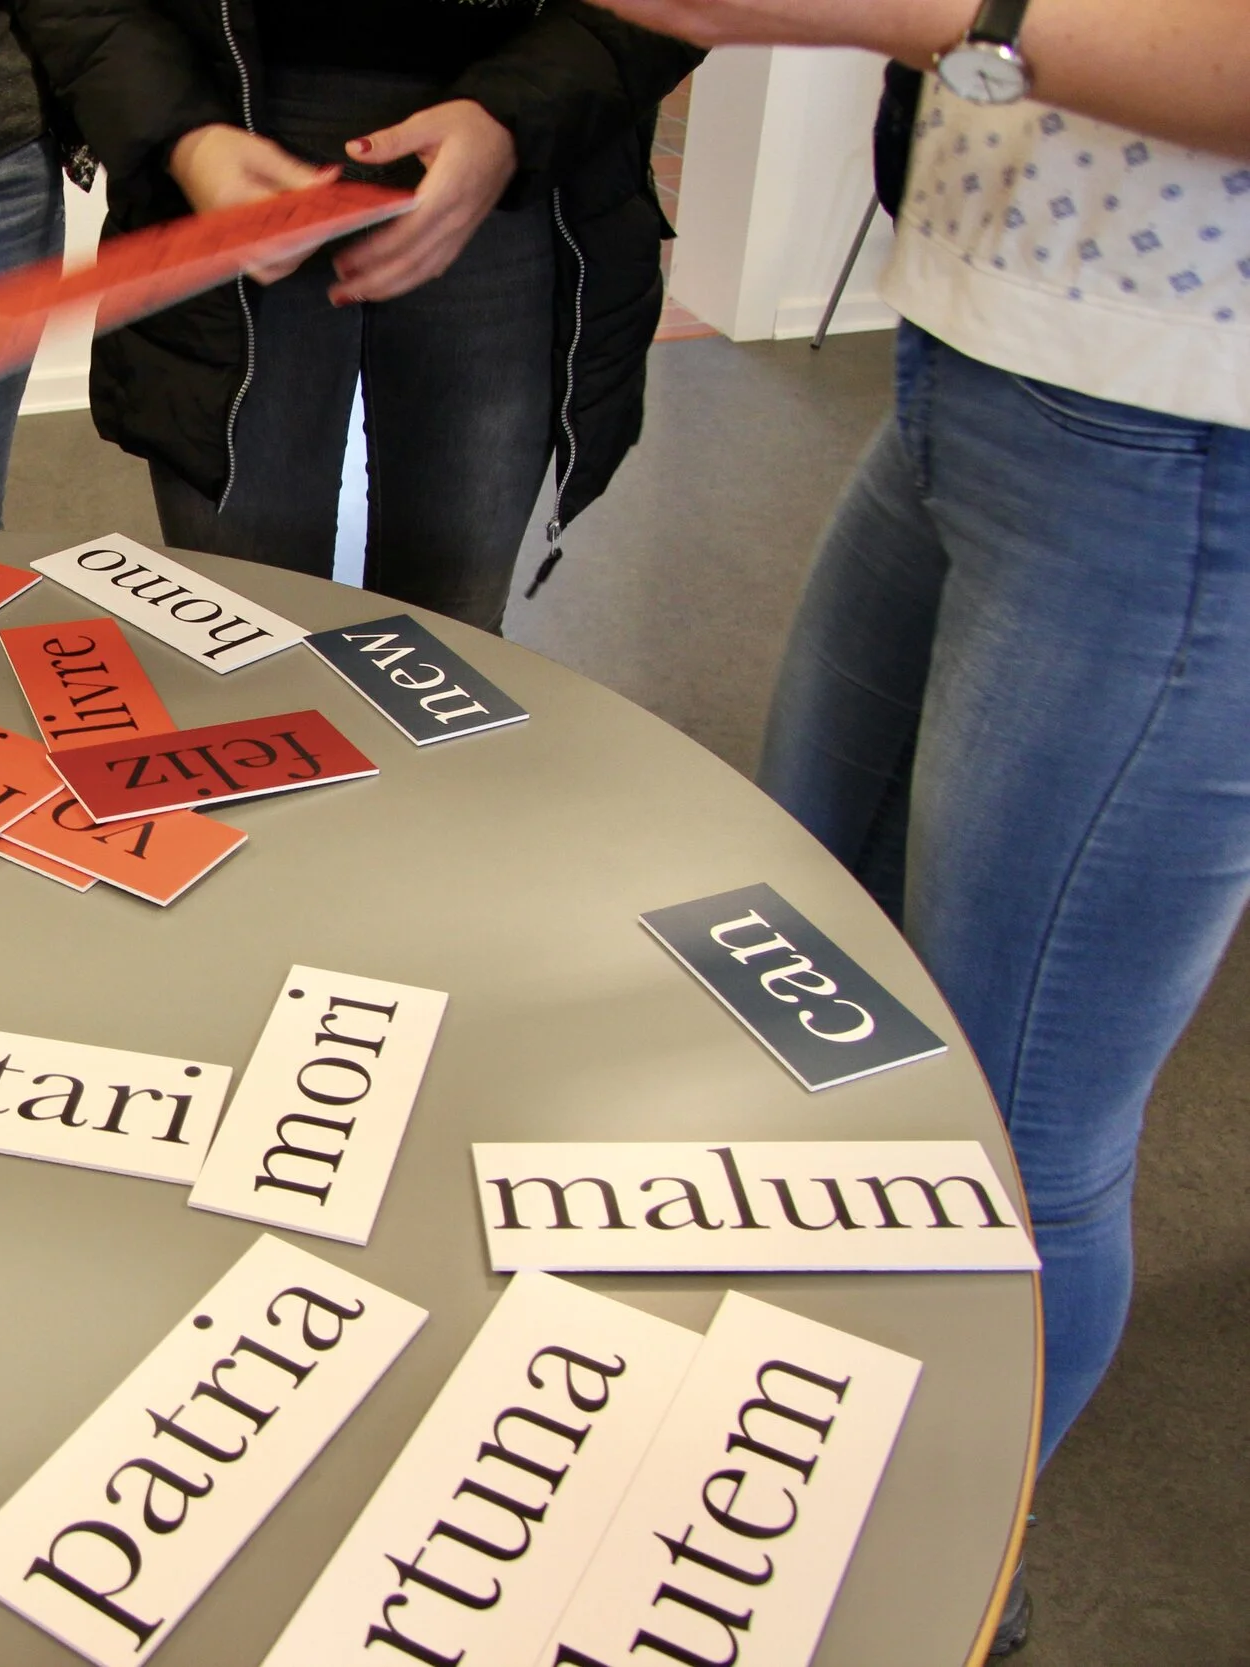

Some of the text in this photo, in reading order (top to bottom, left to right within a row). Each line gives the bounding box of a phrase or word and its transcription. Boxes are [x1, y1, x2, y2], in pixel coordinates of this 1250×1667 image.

[77, 547, 274, 663] homo
[42, 634, 140, 741] livre
[341, 633, 490, 725] new
[105, 730, 322, 797] feliz
[51, 798, 156, 860] vo
[707, 909, 876, 1044] can
[252, 987, 400, 1208] mori
[485, 1146, 1019, 1233] malum
[23, 1285, 367, 1655] patria
[363, 1343, 627, 1667] rtuna
